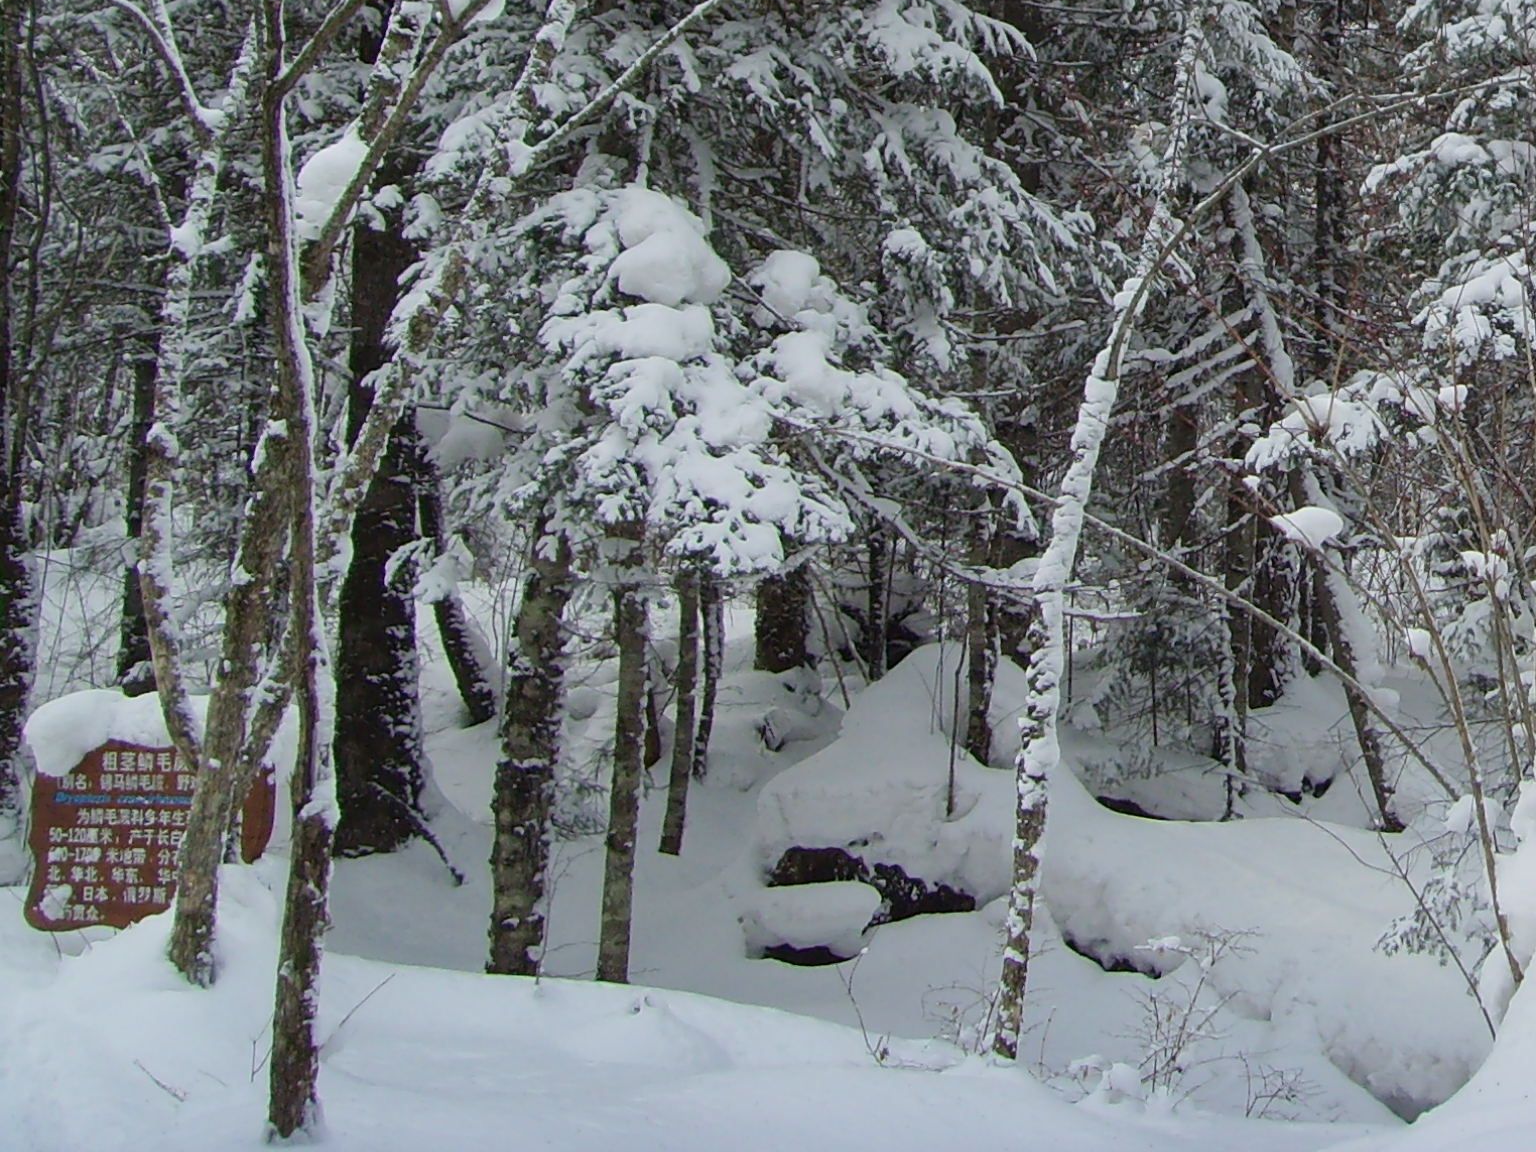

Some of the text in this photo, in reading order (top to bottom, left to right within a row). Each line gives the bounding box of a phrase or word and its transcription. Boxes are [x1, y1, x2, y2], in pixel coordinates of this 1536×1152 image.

[77, 808, 190, 826] 为鳞毛蕨科多年生
